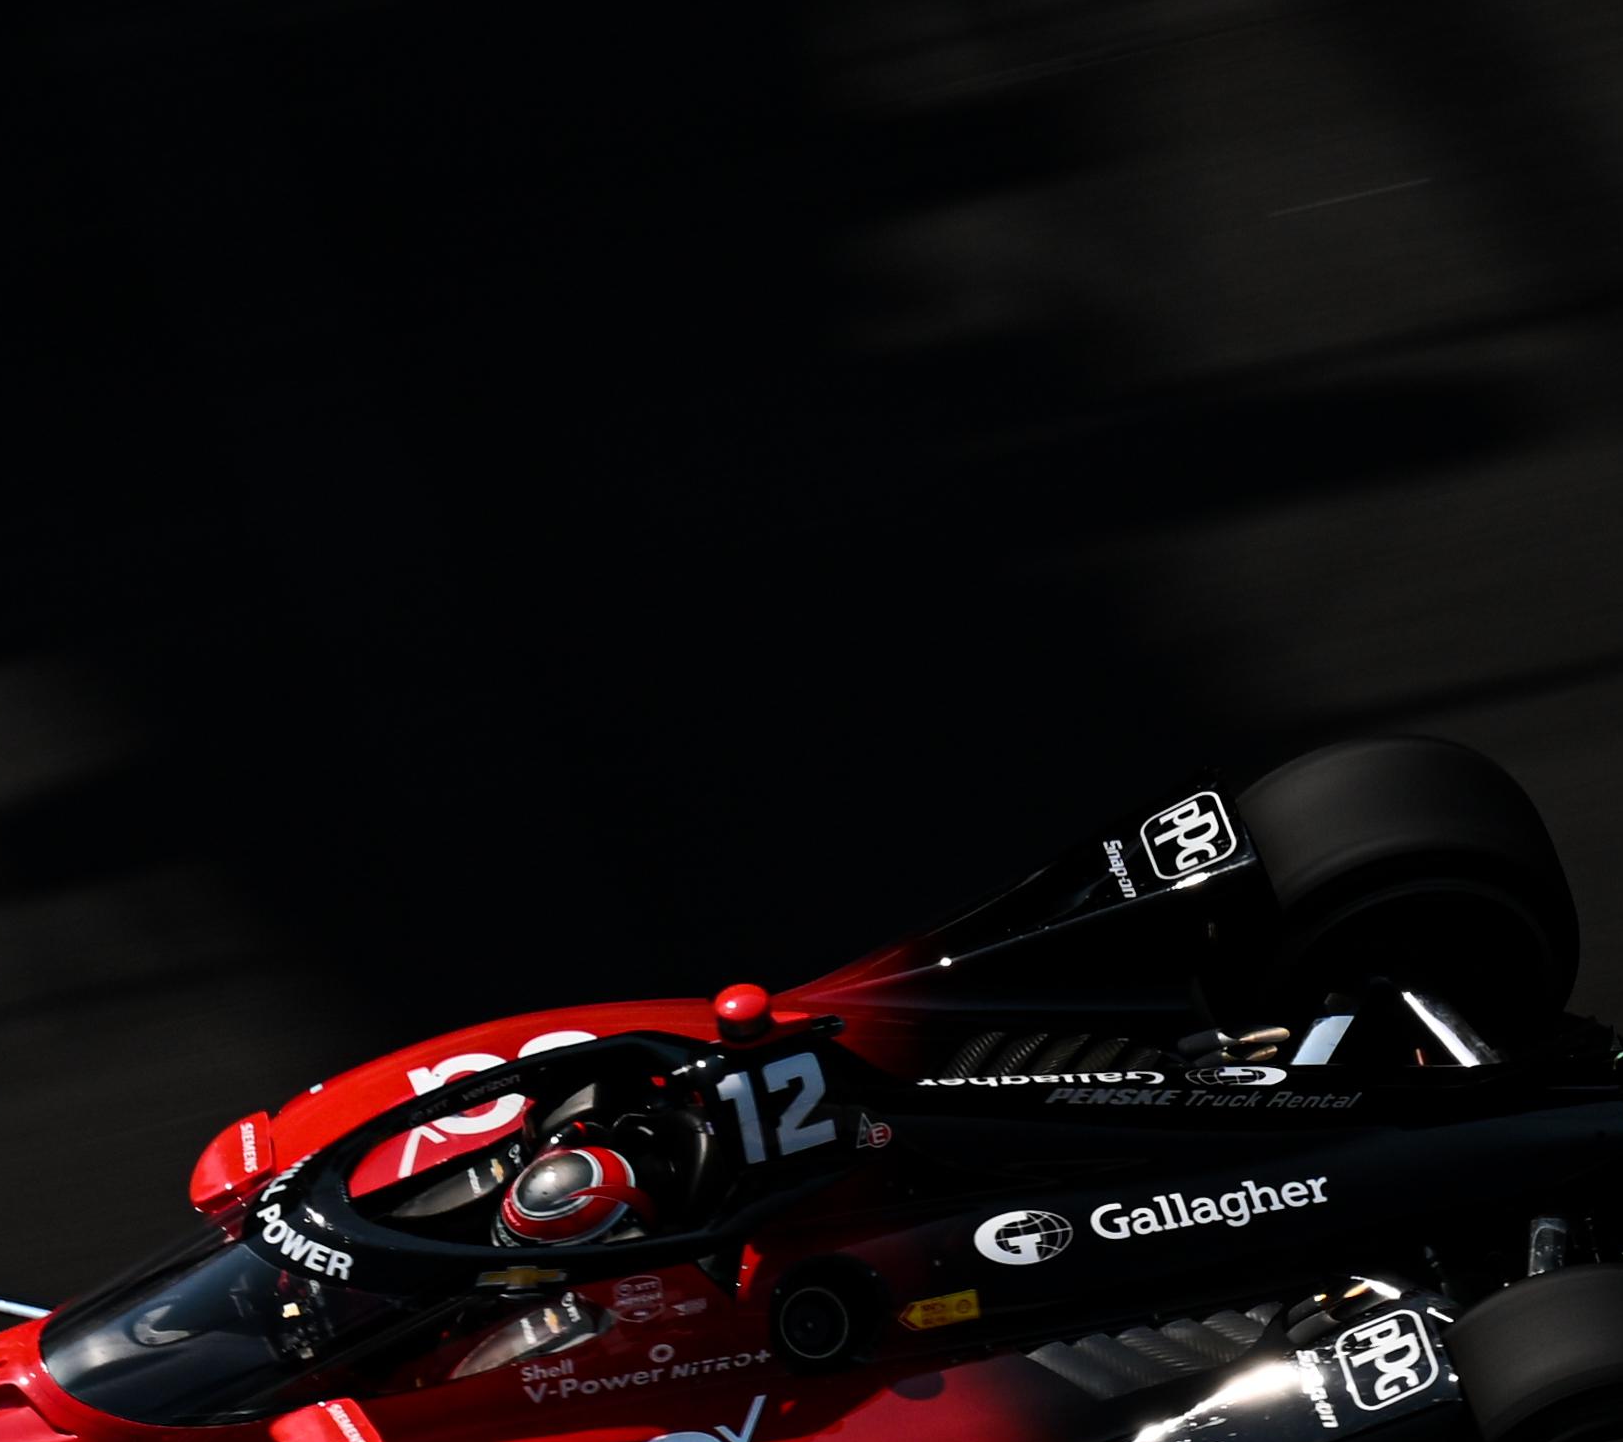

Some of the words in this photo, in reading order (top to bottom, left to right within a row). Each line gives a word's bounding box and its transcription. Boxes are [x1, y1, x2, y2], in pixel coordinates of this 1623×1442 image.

[718, 1052, 838, 1165] 12
[1046, 1087, 1180, 1106] PENSKE
[1185, 1090, 1263, 1109] Truck
[1266, 1091, 1363, 1110] Rental
[240, 1122, 259, 1173] SIEMENS
[1090, 1177, 1328, 1240] Gallagher
[255, 1203, 355, 1281] POWER
[520, 1358, 575, 1383] Shell
[523, 1365, 665, 1404] V-Power
